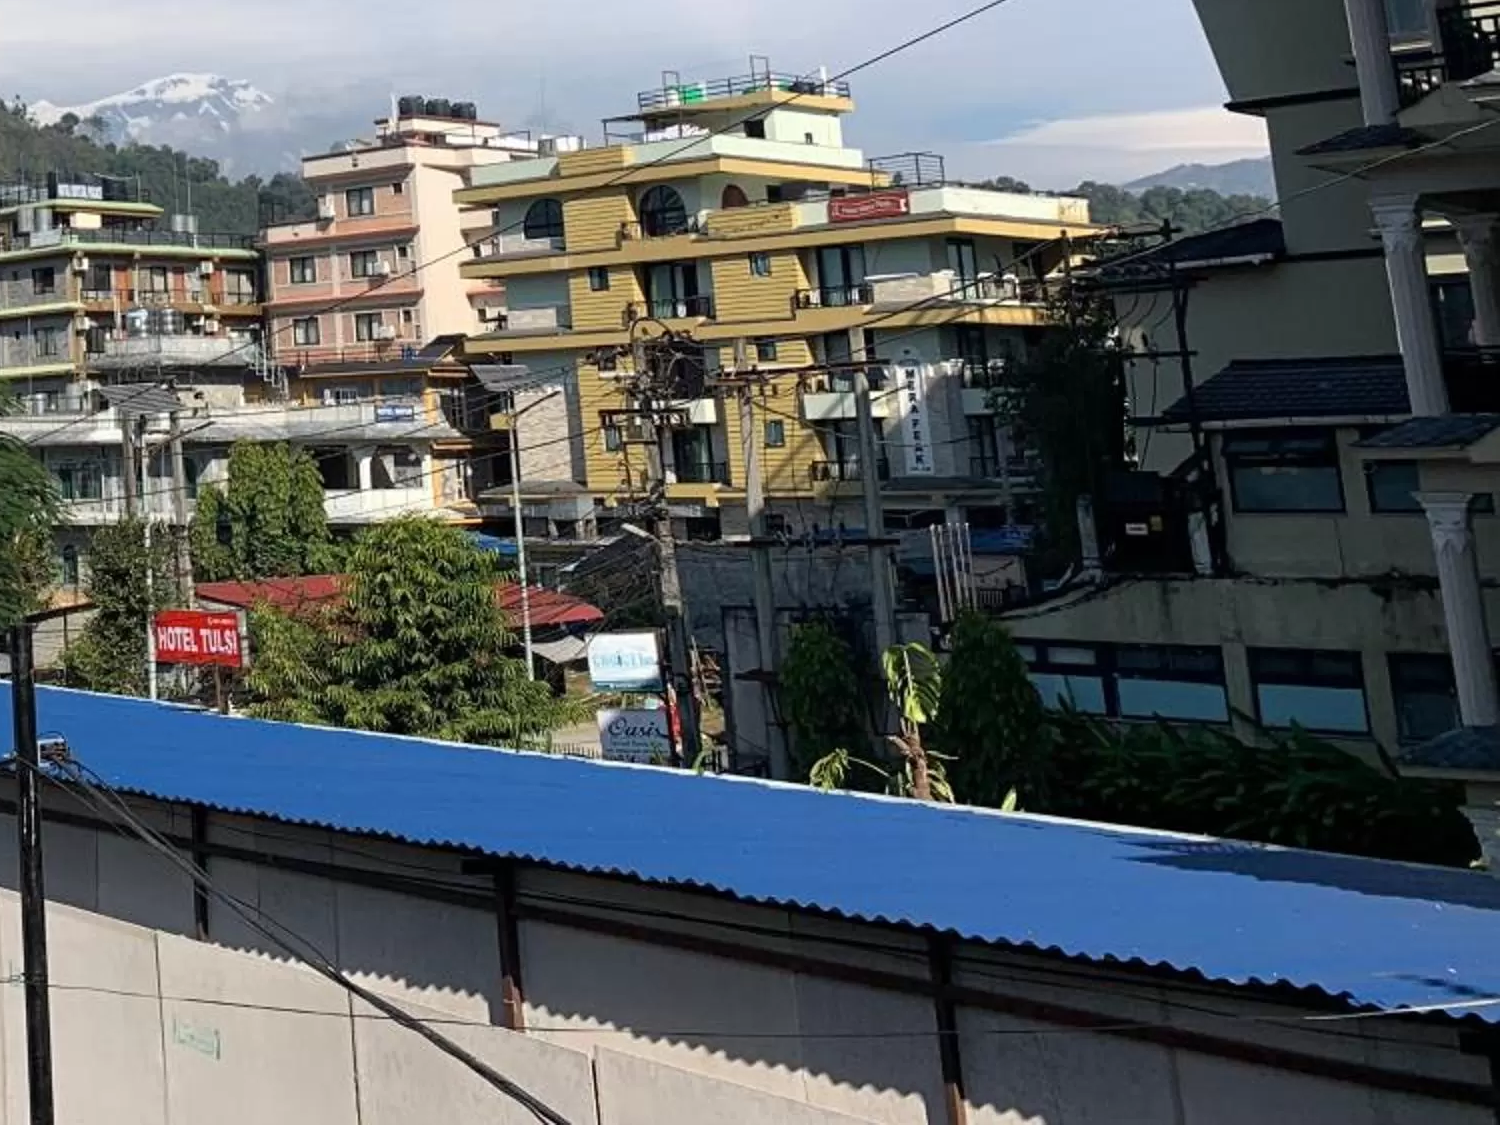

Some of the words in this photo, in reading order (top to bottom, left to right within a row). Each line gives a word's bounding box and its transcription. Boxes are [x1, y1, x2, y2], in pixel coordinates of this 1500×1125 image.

[904, 368, 919, 414] MERA
[157, 626, 199, 652] HOTEL
[199, 627, 238, 655] TULSI
